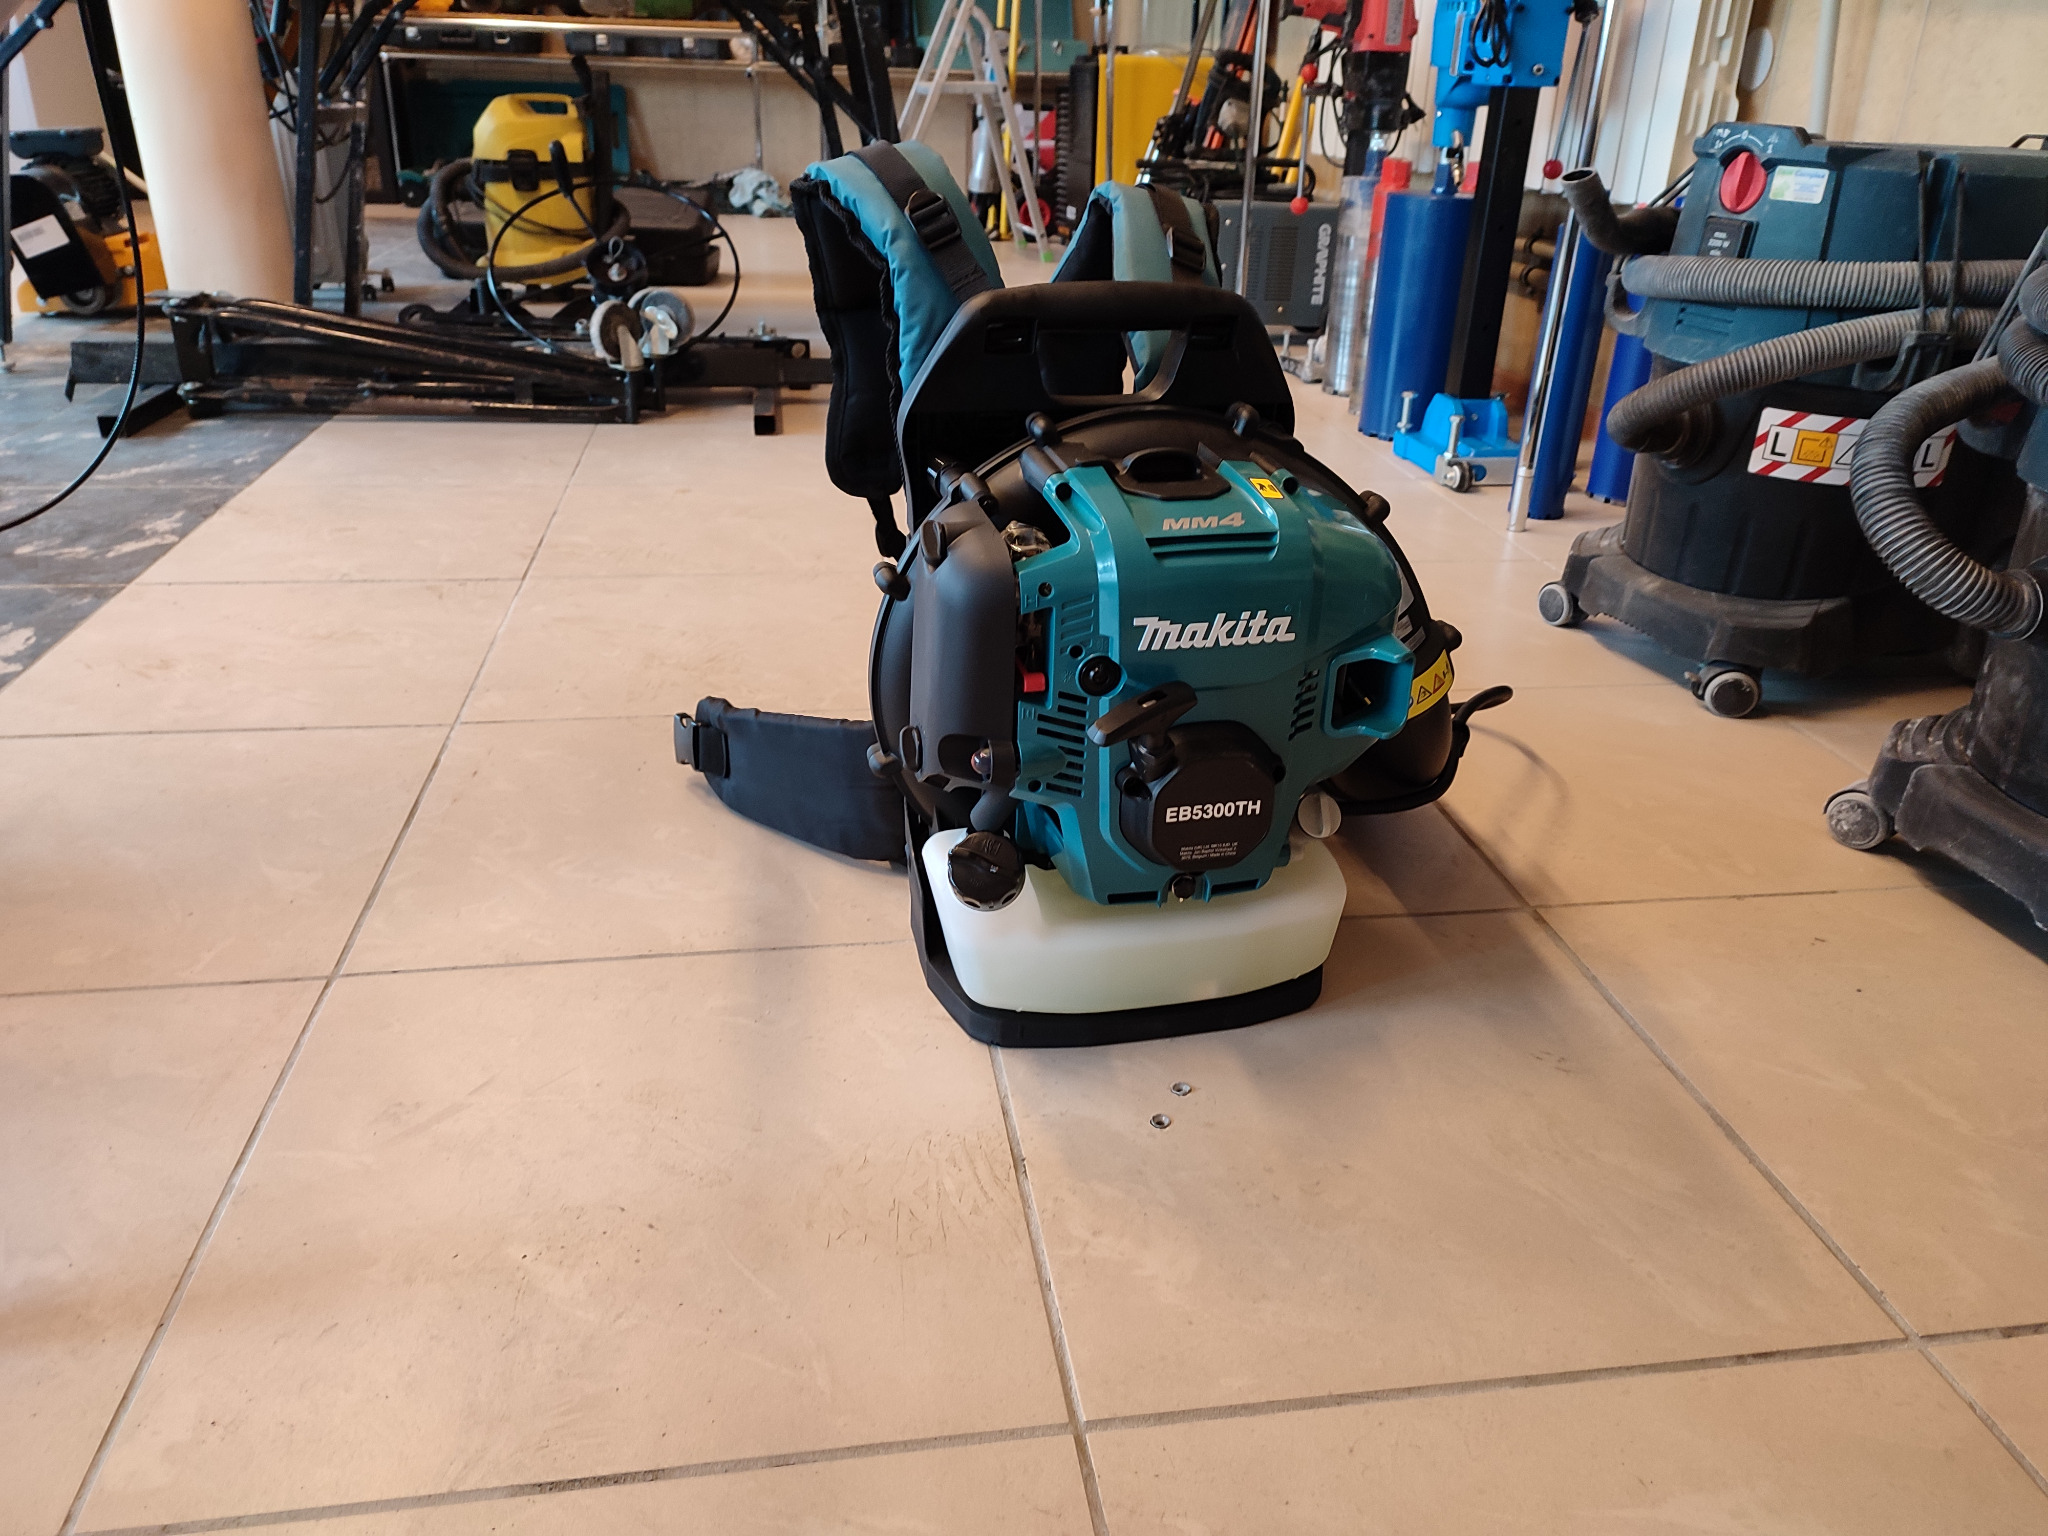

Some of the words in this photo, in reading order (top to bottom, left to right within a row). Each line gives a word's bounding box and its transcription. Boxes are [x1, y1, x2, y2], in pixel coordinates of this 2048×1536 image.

[1310, 223, 1332, 305] GRAPHITE
[1770, 431, 1787, 457] L
[1920, 443, 1934, 468] L
[1162, 511, 1246, 531] MM4
[1133, 609, 1297, 652] Makita
[1165, 799, 1261, 823] EB5300TH
